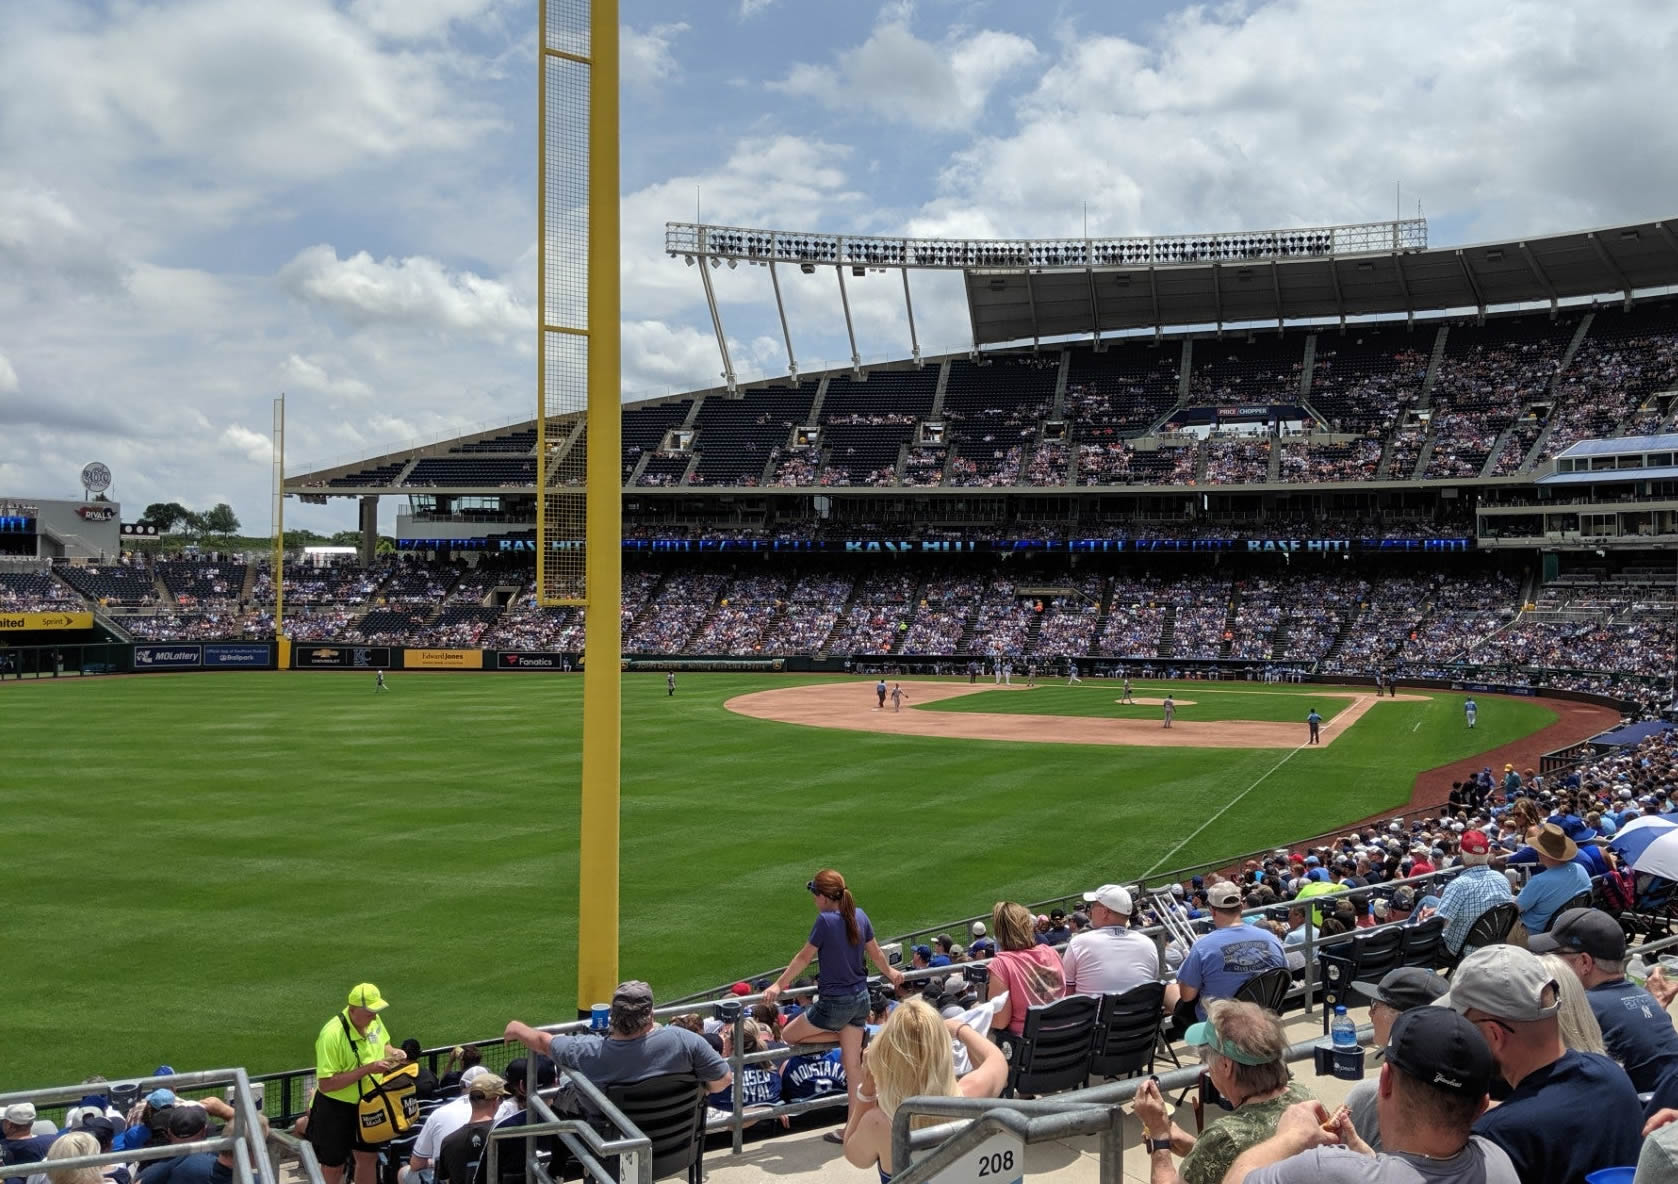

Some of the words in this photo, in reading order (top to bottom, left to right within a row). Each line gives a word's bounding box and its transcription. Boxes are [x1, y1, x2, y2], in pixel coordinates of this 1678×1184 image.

[85, 511, 112, 519] RIVALS
[845, 541, 913, 552] BASE
[1247, 540, 1300, 551] BASE
[1307, 540, 1350, 551] HIT!
[42, 618, 63, 627] Sprint
[155, 651, 198, 661] MOLottery
[227, 654, 254, 662] Ballpark
[519, 657, 552, 666] Fanatics
[362, 1112, 384, 1122] Minute
[366, 1118, 382, 1126] Maid
[978, 1150, 1014, 1177] 208
